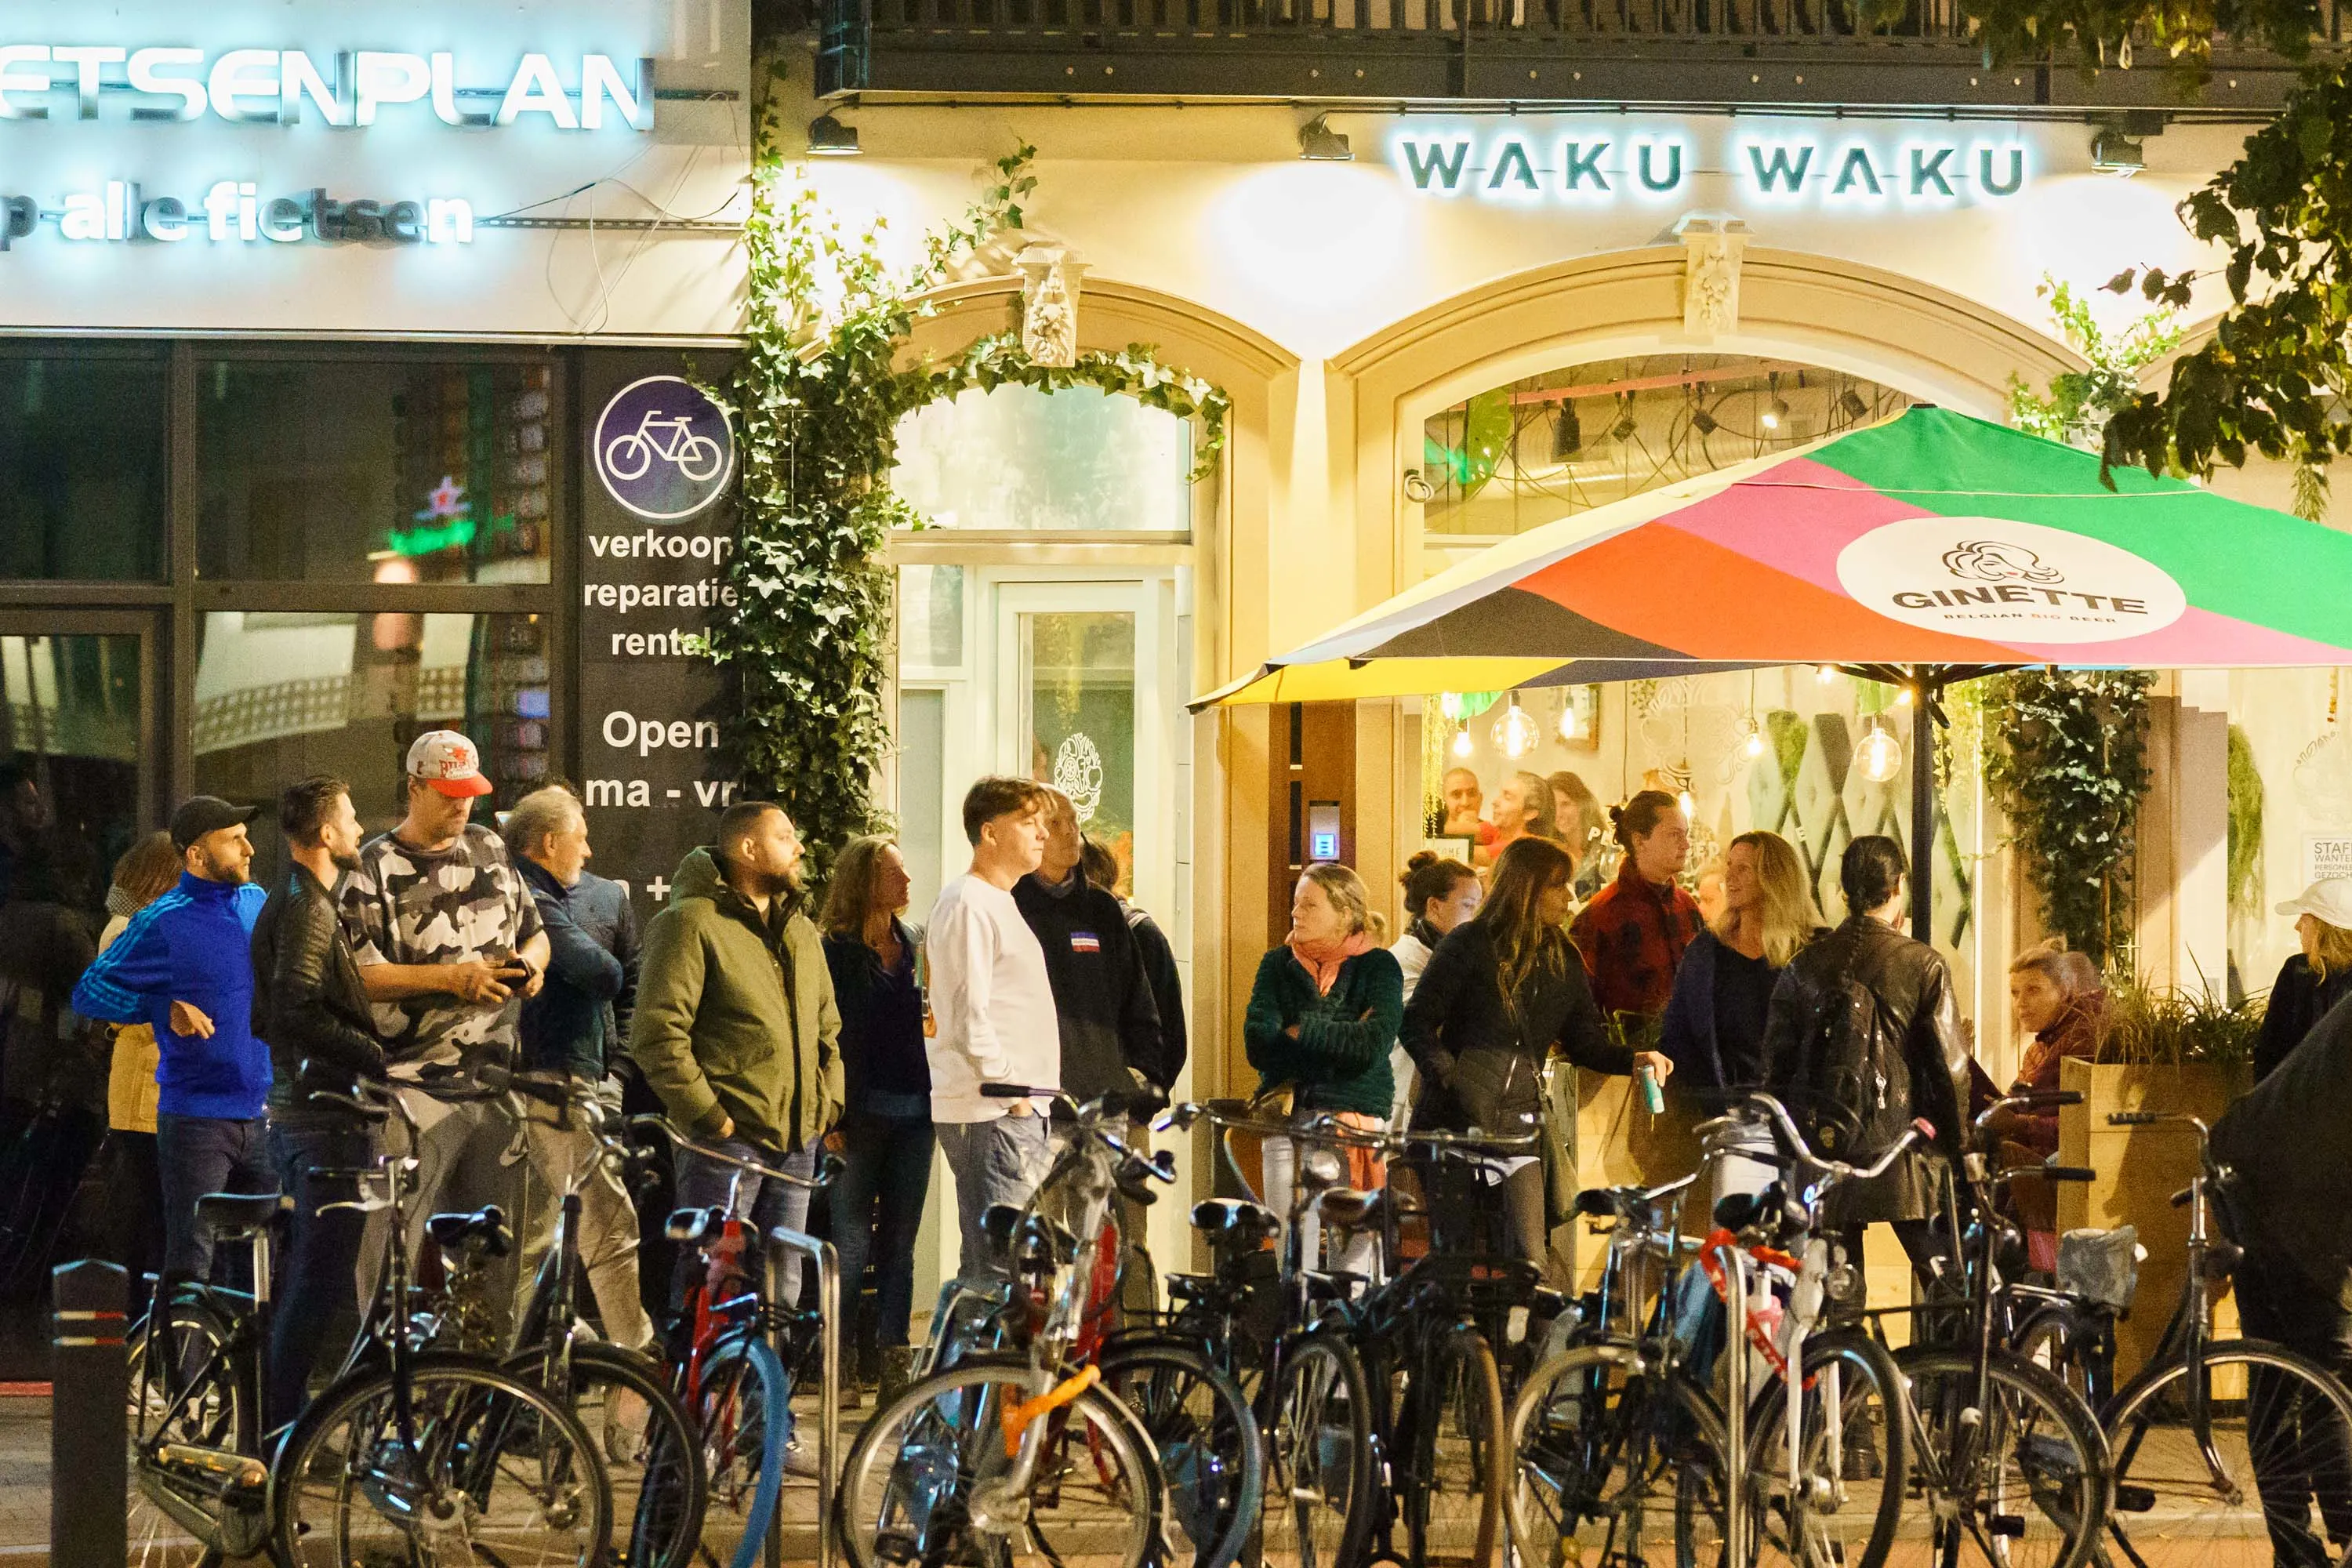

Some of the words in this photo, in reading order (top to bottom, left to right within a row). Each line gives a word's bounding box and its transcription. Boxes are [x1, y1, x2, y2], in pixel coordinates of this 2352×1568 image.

[1403, 141, 1682, 191] WAKU
[1747, 145, 2023, 196] WAKU
[60, 180, 189, 242] alle
[204, 181, 474, 244] fietsen
[589, 528, 734, 565] verkoop
[584, 578, 739, 614] reparatie
[1892, 585, 2149, 615] GINETTE
[602, 710, 719, 757] Open
[586, 779, 651, 807] ma
[693, 780, 739, 808] vr
[2314, 842, 2352, 854] STAF
[2314, 854, 2352, 862] WANTE
